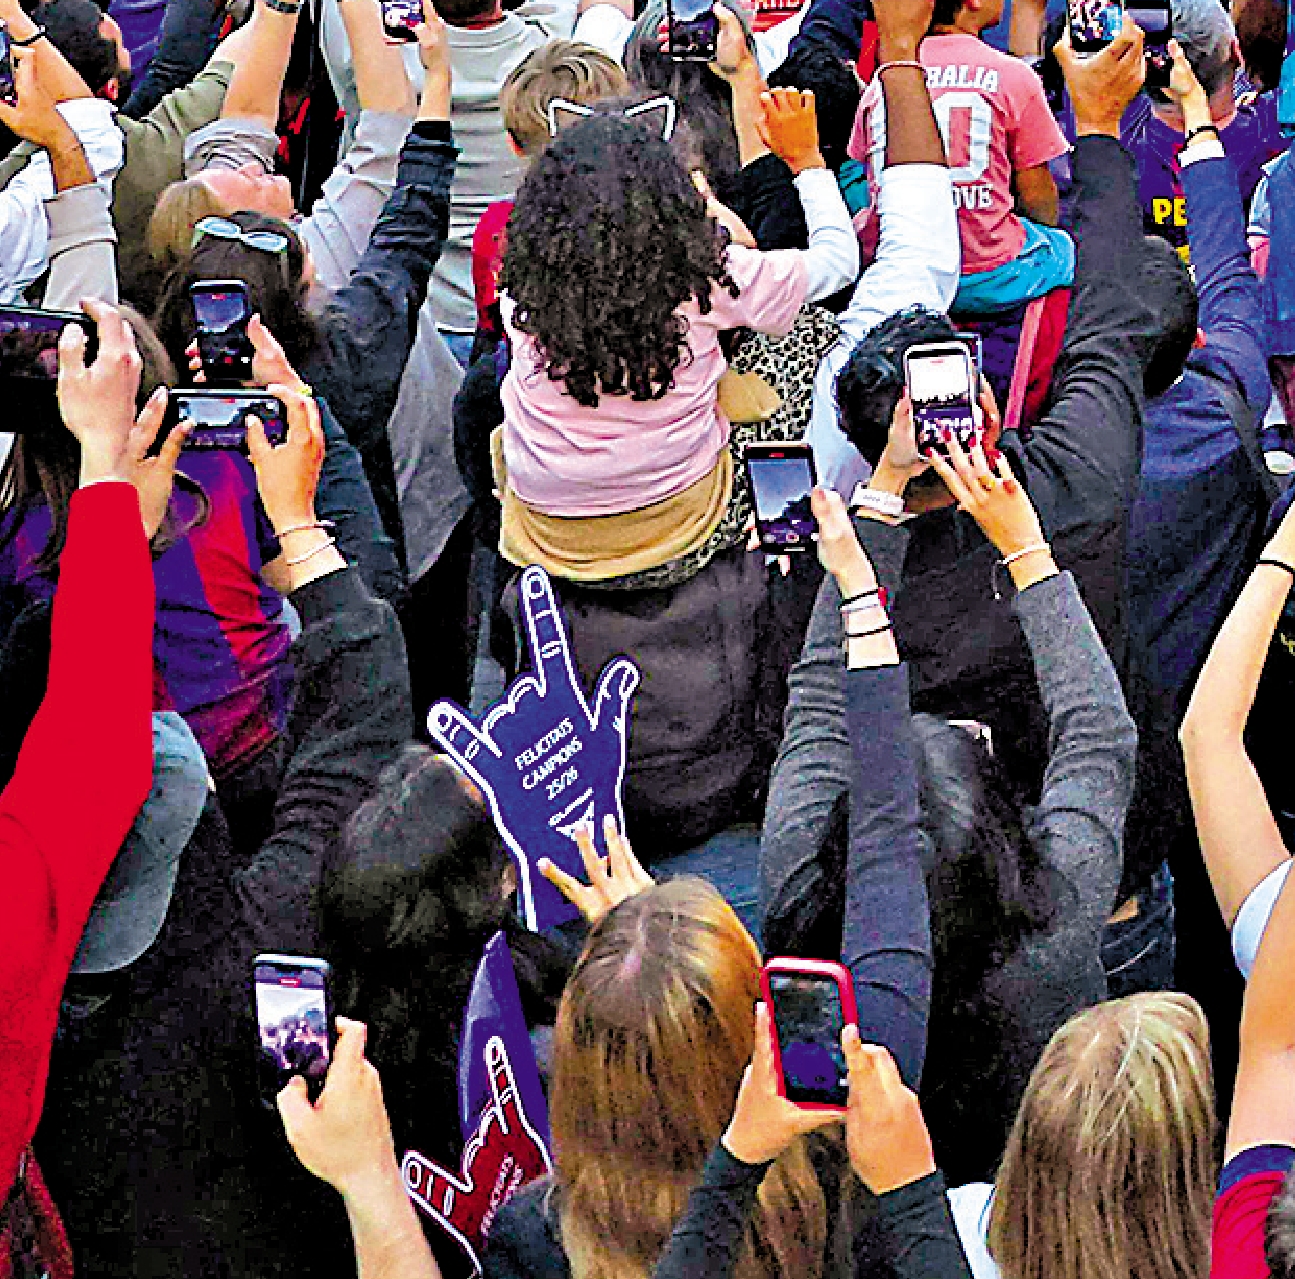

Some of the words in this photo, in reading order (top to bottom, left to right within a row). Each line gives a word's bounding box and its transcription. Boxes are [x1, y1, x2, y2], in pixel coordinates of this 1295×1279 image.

[926, 64, 998, 93] RALIA
[1152, 198, 1188, 227] PE
[514, 716, 575, 773] FELICITATS
[521, 737, 583, 795] CAMPIONS
[545, 765, 579, 802] 25/26
